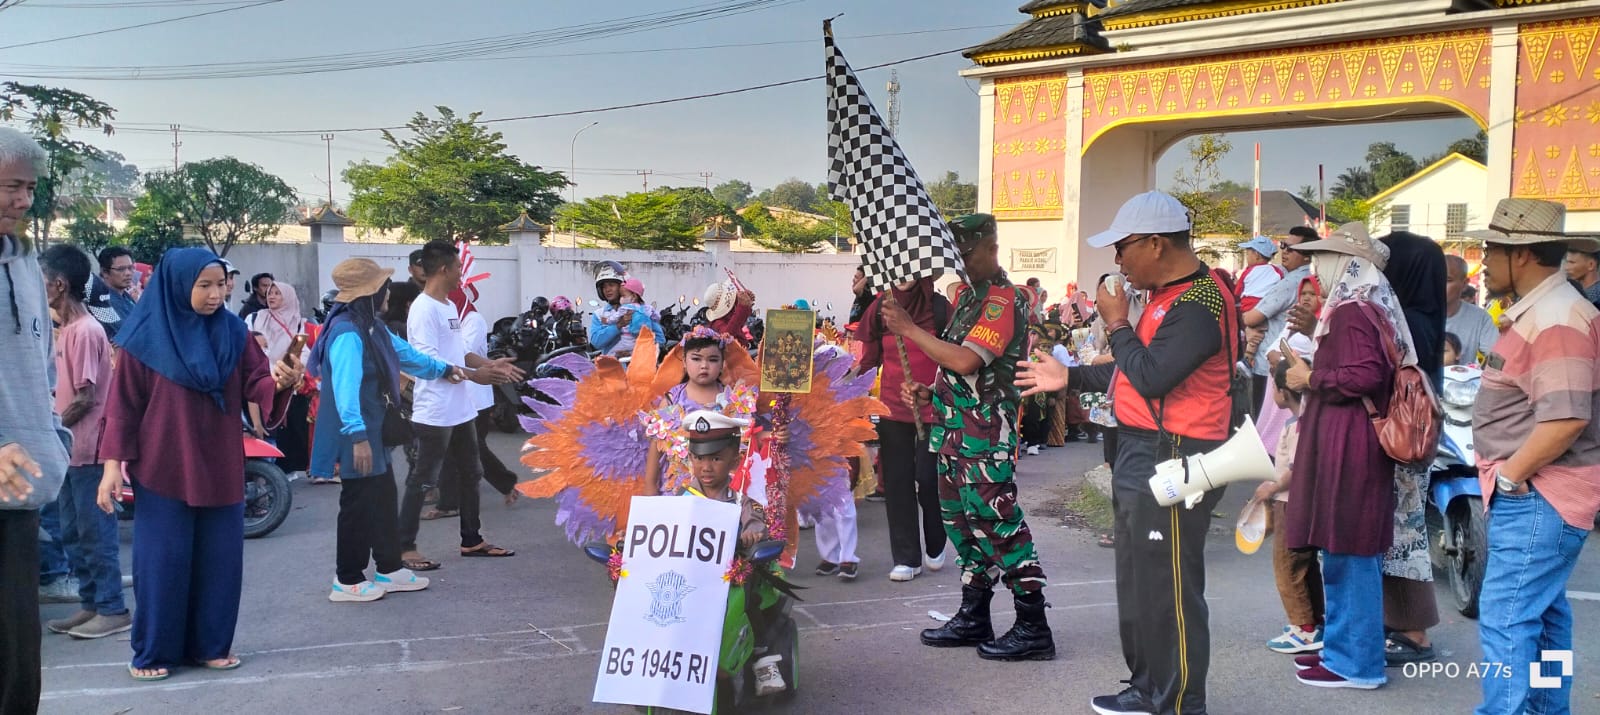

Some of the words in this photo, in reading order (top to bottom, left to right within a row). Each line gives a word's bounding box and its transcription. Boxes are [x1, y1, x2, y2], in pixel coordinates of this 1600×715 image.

[1162, 478, 1177, 499] TUM
[629, 524, 726, 564] POLISI
[606, 647, 635, 676] BG
[641, 649, 683, 680] 1945
[687, 654, 709, 684] RI
